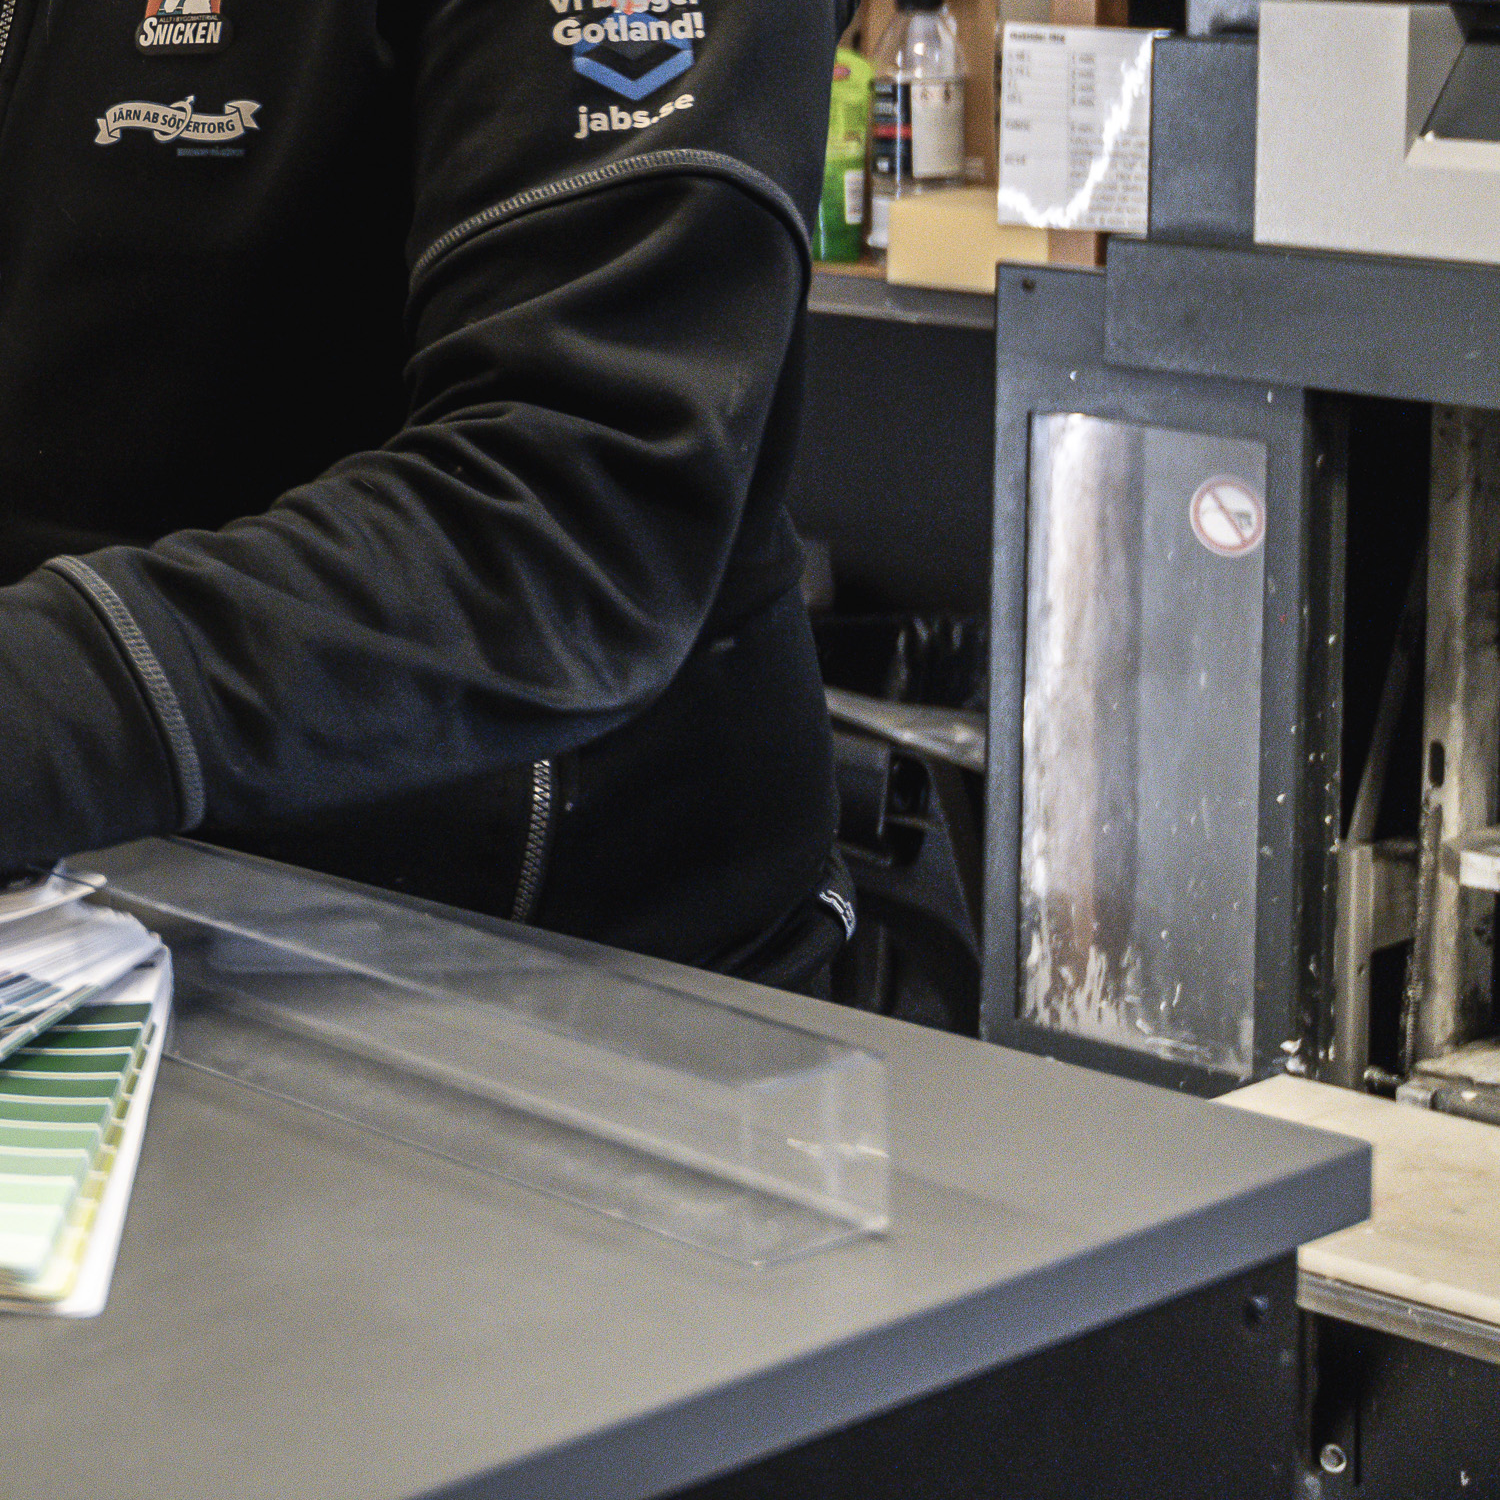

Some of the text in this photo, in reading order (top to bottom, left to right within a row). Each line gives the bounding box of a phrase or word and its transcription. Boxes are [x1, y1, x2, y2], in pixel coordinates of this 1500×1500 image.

[552, 11, 705, 46] Gotland!
[112, 107, 236, 134] JÄRN AB SÖDERTORG
[574, 93, 695, 139] jabs.se
